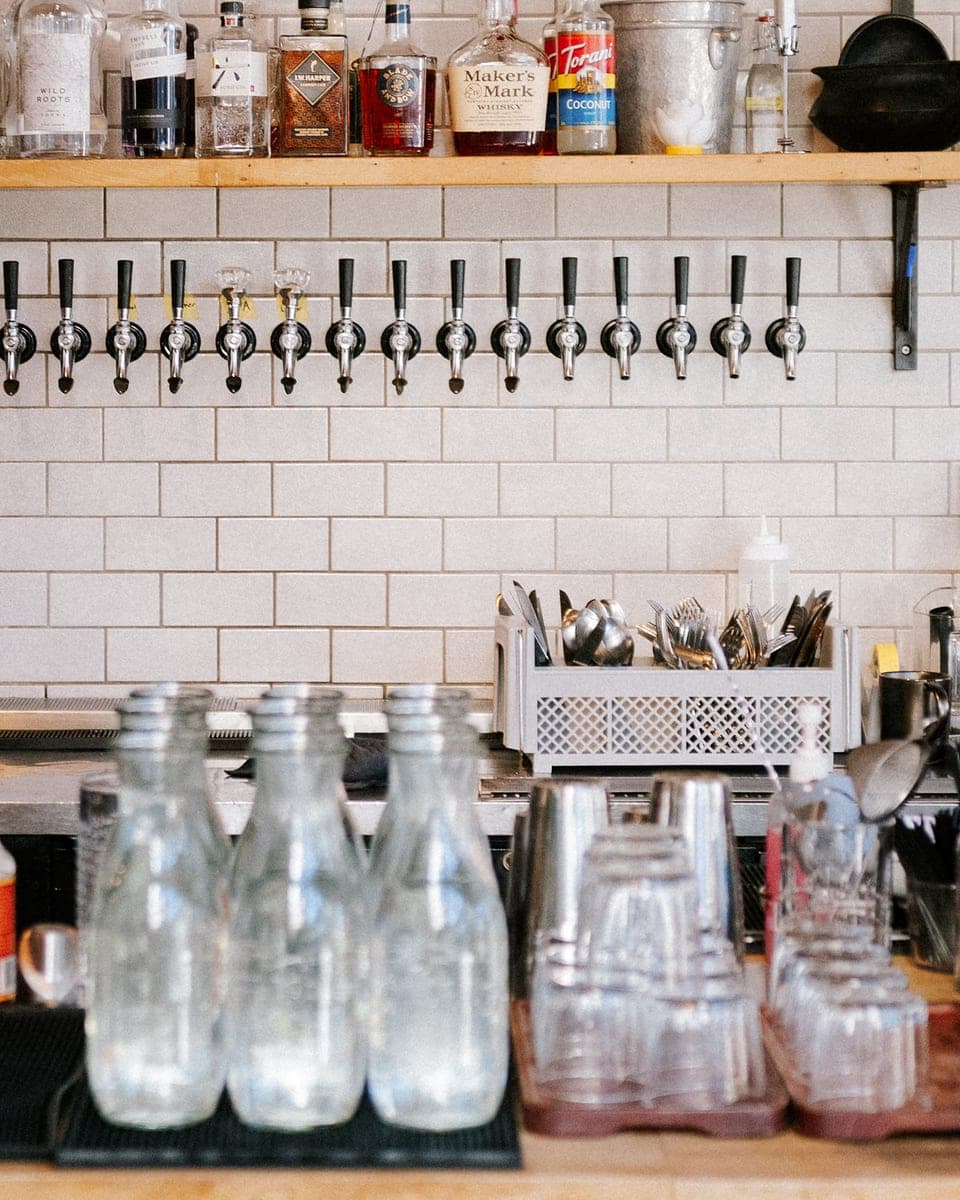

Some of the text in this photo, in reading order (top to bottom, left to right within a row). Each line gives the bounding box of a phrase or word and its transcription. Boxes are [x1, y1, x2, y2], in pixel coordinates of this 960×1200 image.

[560, 42, 614, 77] Torani
[464, 70, 536, 82] Maker's
[483, 85, 534, 98] Mark
[566, 99, 611, 110] COCONUT
